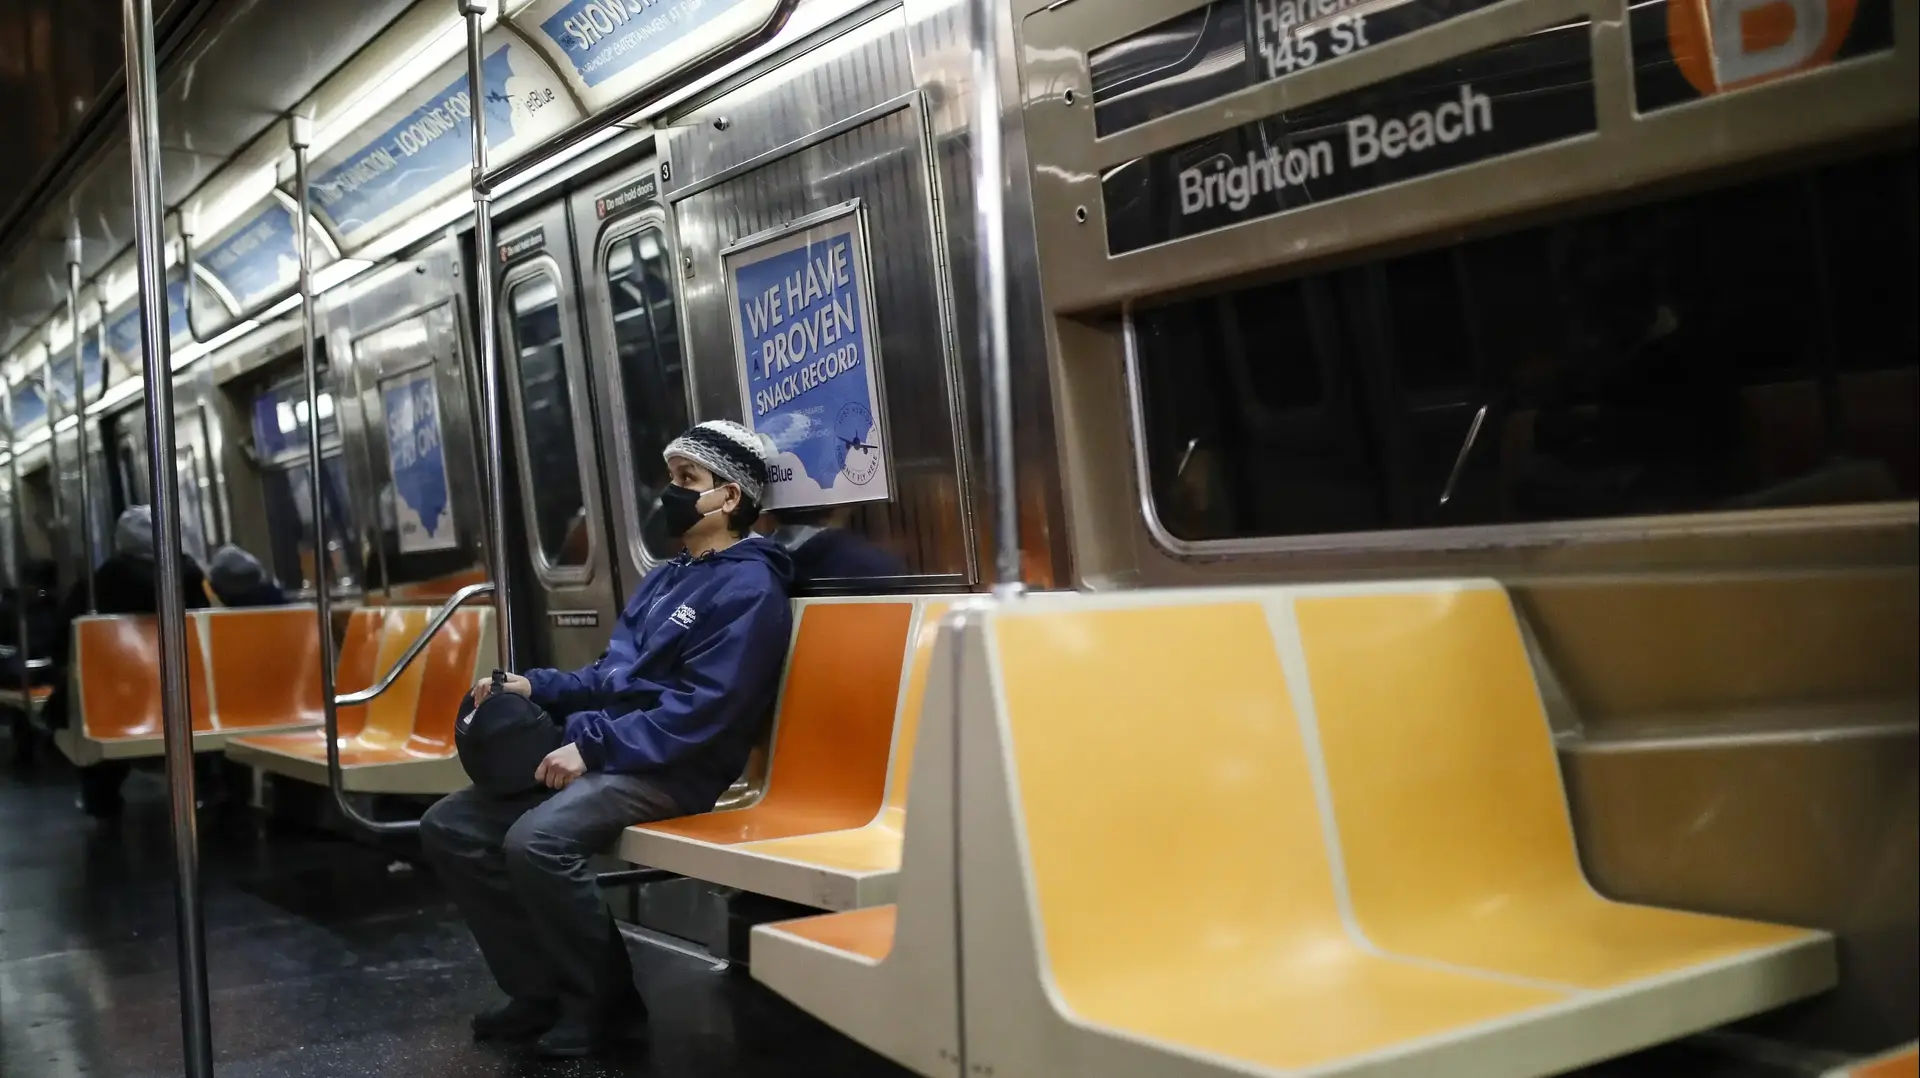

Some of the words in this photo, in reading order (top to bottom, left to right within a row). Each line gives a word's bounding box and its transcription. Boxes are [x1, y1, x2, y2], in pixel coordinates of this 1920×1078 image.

[1259, 33, 1318, 79] 145
[1329, 13, 1369, 57] St
[396, 105, 455, 157] LOOKING
[526, 87, 555, 117] jetBlue
[662, 164, 669, 179] 3
[1179, 139, 1334, 215] Brighton
[1347, 84, 1493, 168] Beach
[606, 199, 615, 210] Do
[614, 193, 625, 207] not
[624, 188, 637, 202] hold
[636, 182, 653, 197] doors
[745, 283, 784, 339] WE
[785, 241, 850, 317] HAVE
[752, 356, 760, 373] A
[762, 292, 856, 380] PROVEN
[756, 371, 801, 416] SNACK
[801, 342, 860, 393] RECORD.
[764, 464, 793, 483] etBlue
